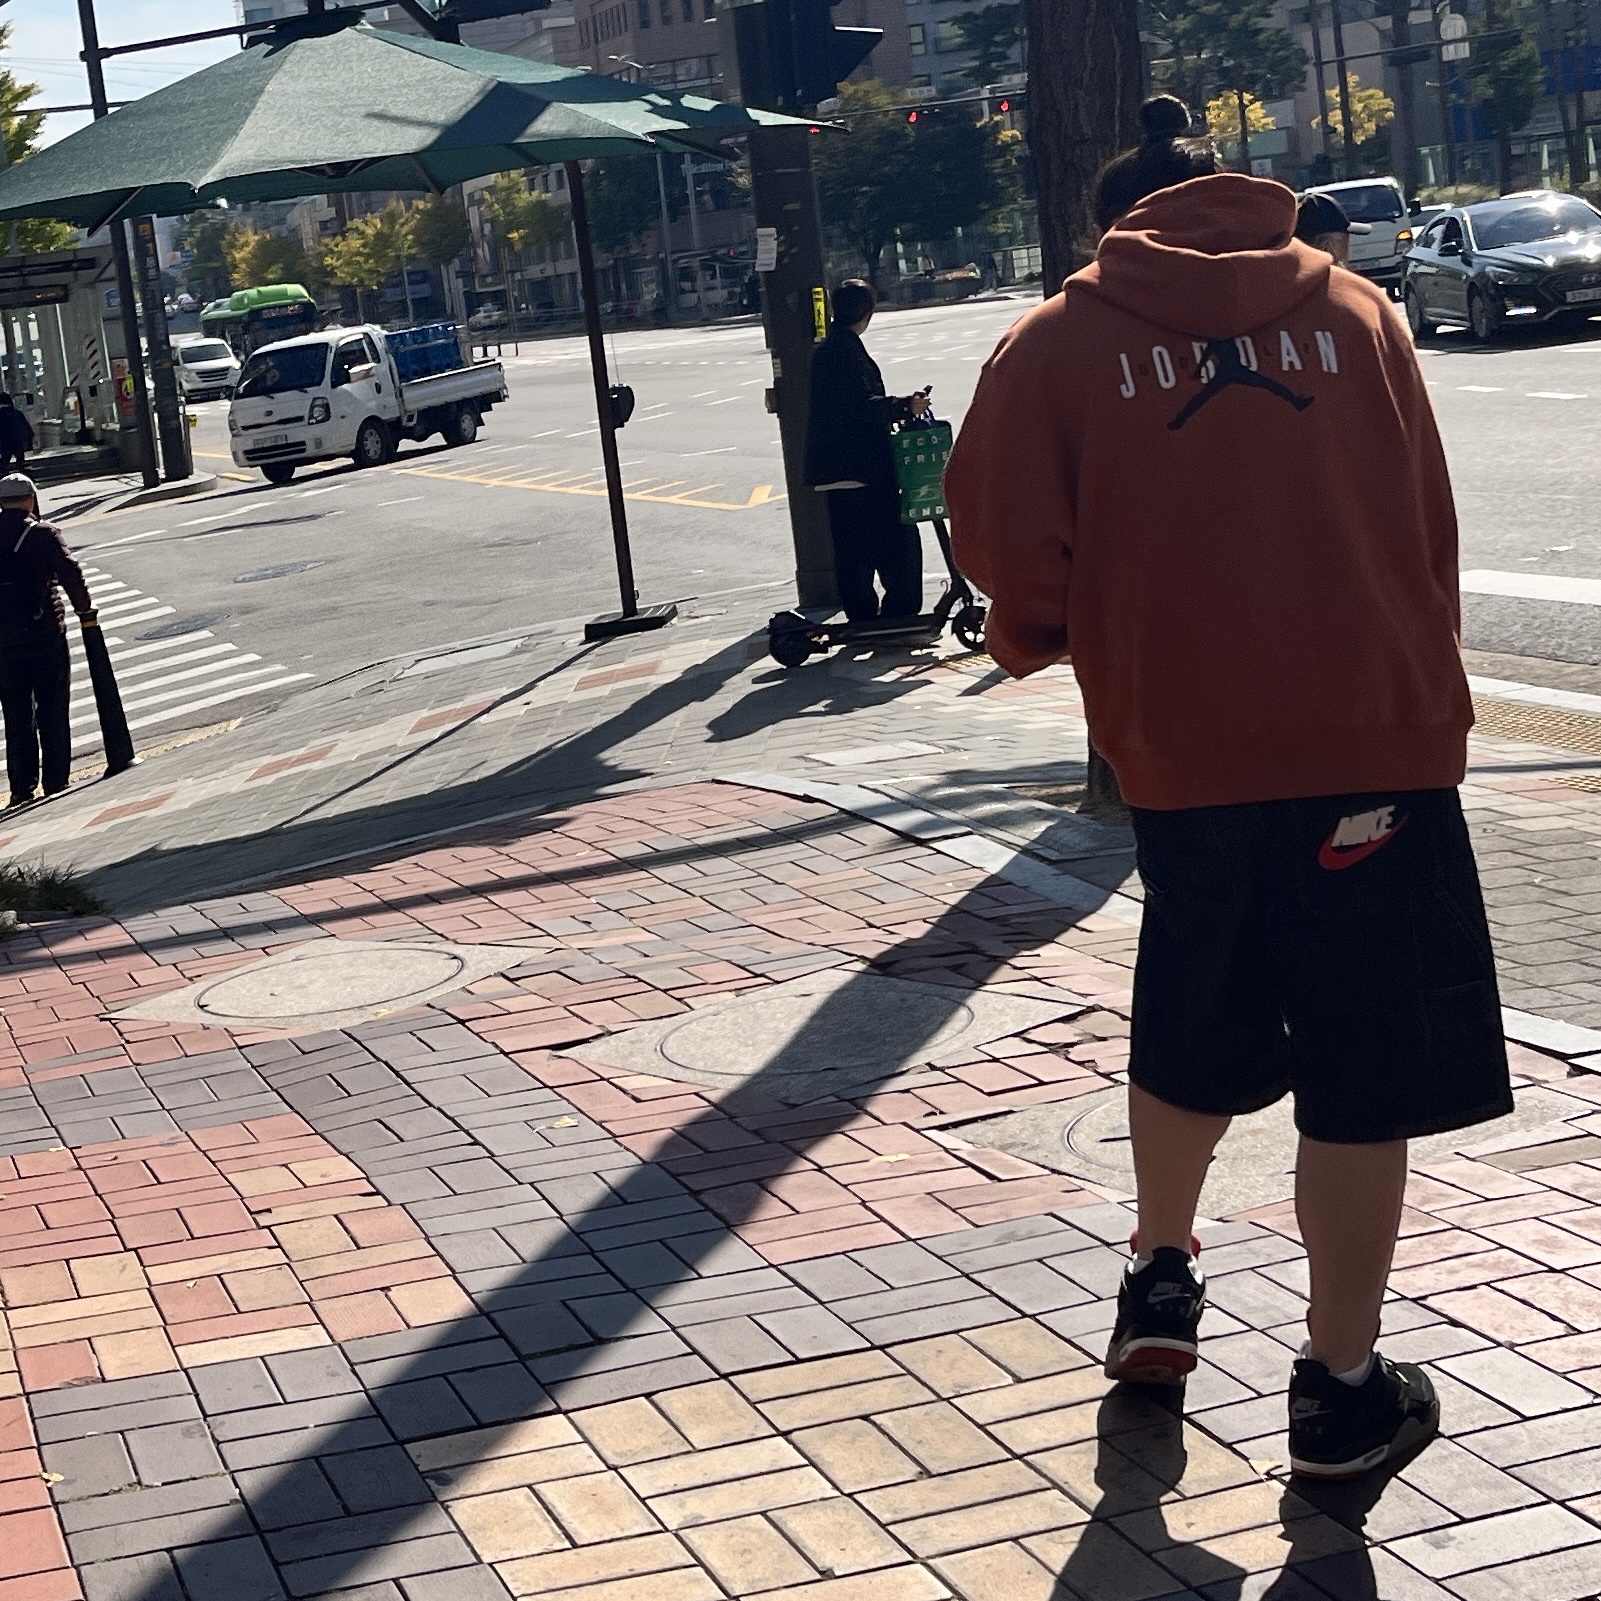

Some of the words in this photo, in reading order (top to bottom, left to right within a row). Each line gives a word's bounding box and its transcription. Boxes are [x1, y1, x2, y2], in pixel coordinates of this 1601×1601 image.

[903, 435, 938, 449] ECO
[909, 505, 944, 518] END
[1331, 805, 1395, 847] NIKE
